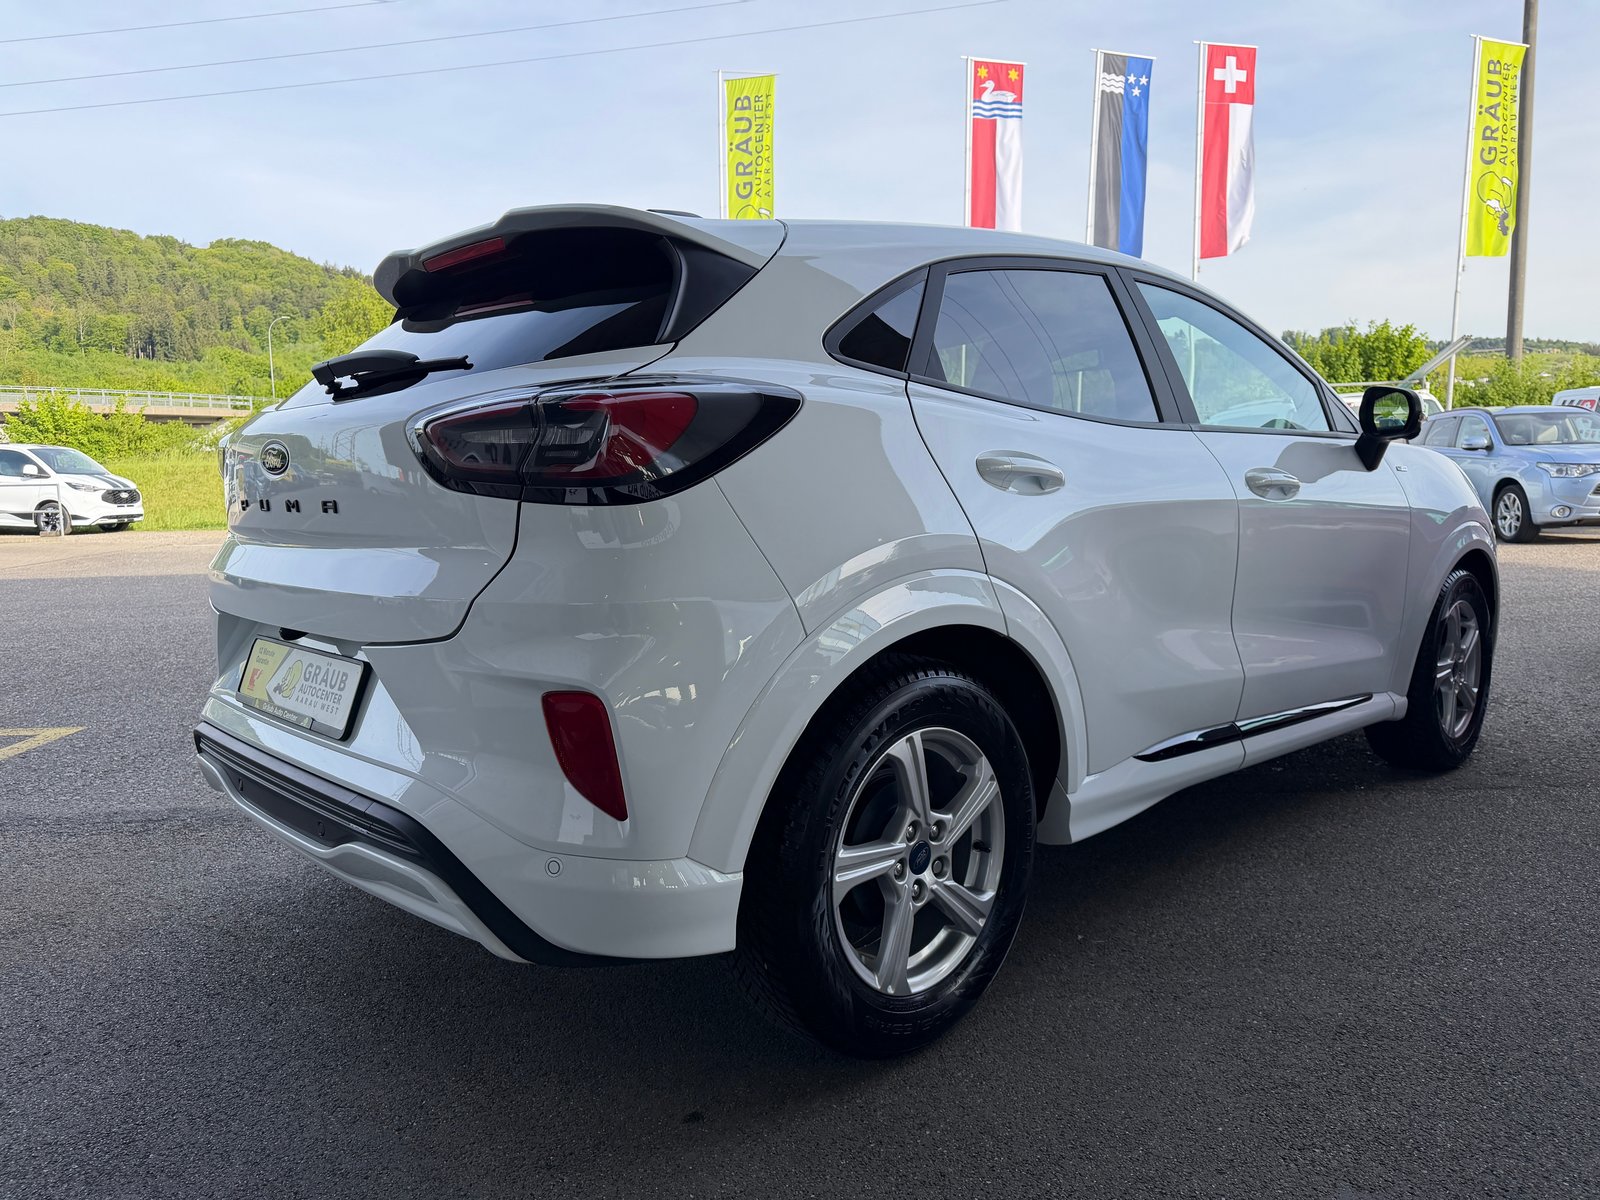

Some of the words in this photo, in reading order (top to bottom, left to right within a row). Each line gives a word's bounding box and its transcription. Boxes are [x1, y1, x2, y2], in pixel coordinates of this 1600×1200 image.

[1510, 64, 1518, 104] WEST
[1478, 59, 1502, 165] GRÄUB
[1499, 62, 1512, 166] AUTOCENTER
[729, 95, 753, 199] GRÄUB
[754, 94, 765, 197] AUTOCENTER
[1510, 114, 1518, 167] AARAU
[240, 499, 339, 514] PUMA
[298, 683, 343, 706] AUTOCENTER
[303, 661, 349, 692] GRÄUB
[295, 694, 319, 710] AARAU
[320, 702, 339, 715] WEST
